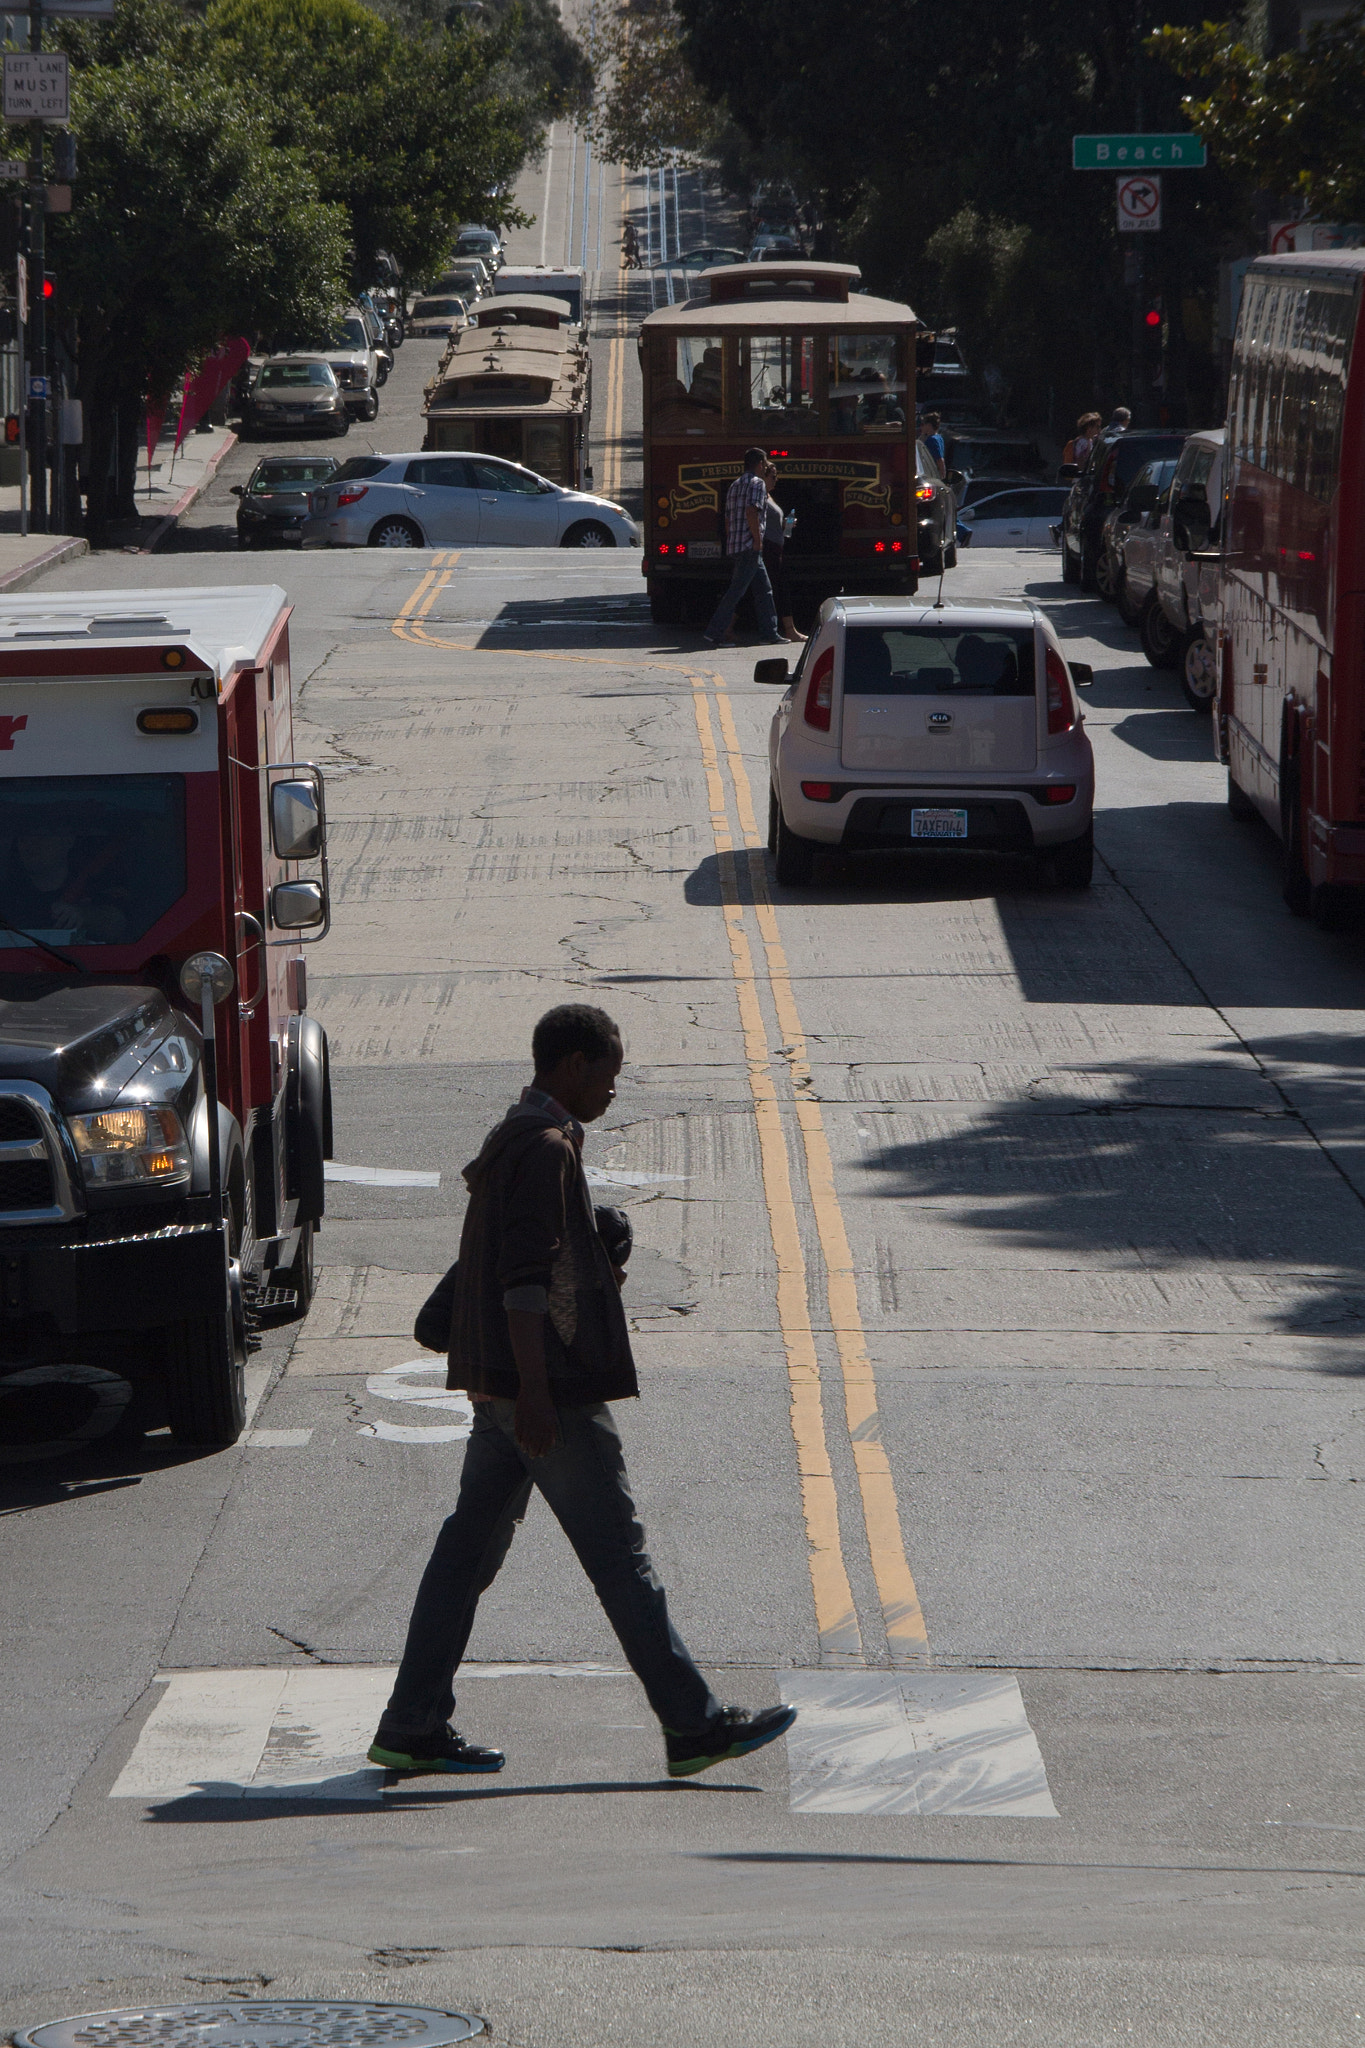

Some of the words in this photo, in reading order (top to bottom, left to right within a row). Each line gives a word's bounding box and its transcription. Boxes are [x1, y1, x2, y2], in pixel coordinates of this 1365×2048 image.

[7, 62, 29, 73] LEFT
[40, 62, 63, 73] LANE
[14, 80, 58, 92] MUST
[8, 98, 32, 109] TURN
[41, 98, 63, 109] LEFT
[1096, 143, 1184, 161] Beach
[701, 464, 745, 477] PRESIDI
[784, 463, 856, 475] CALIFORNIA
[931, 713, 949, 721] KIA
